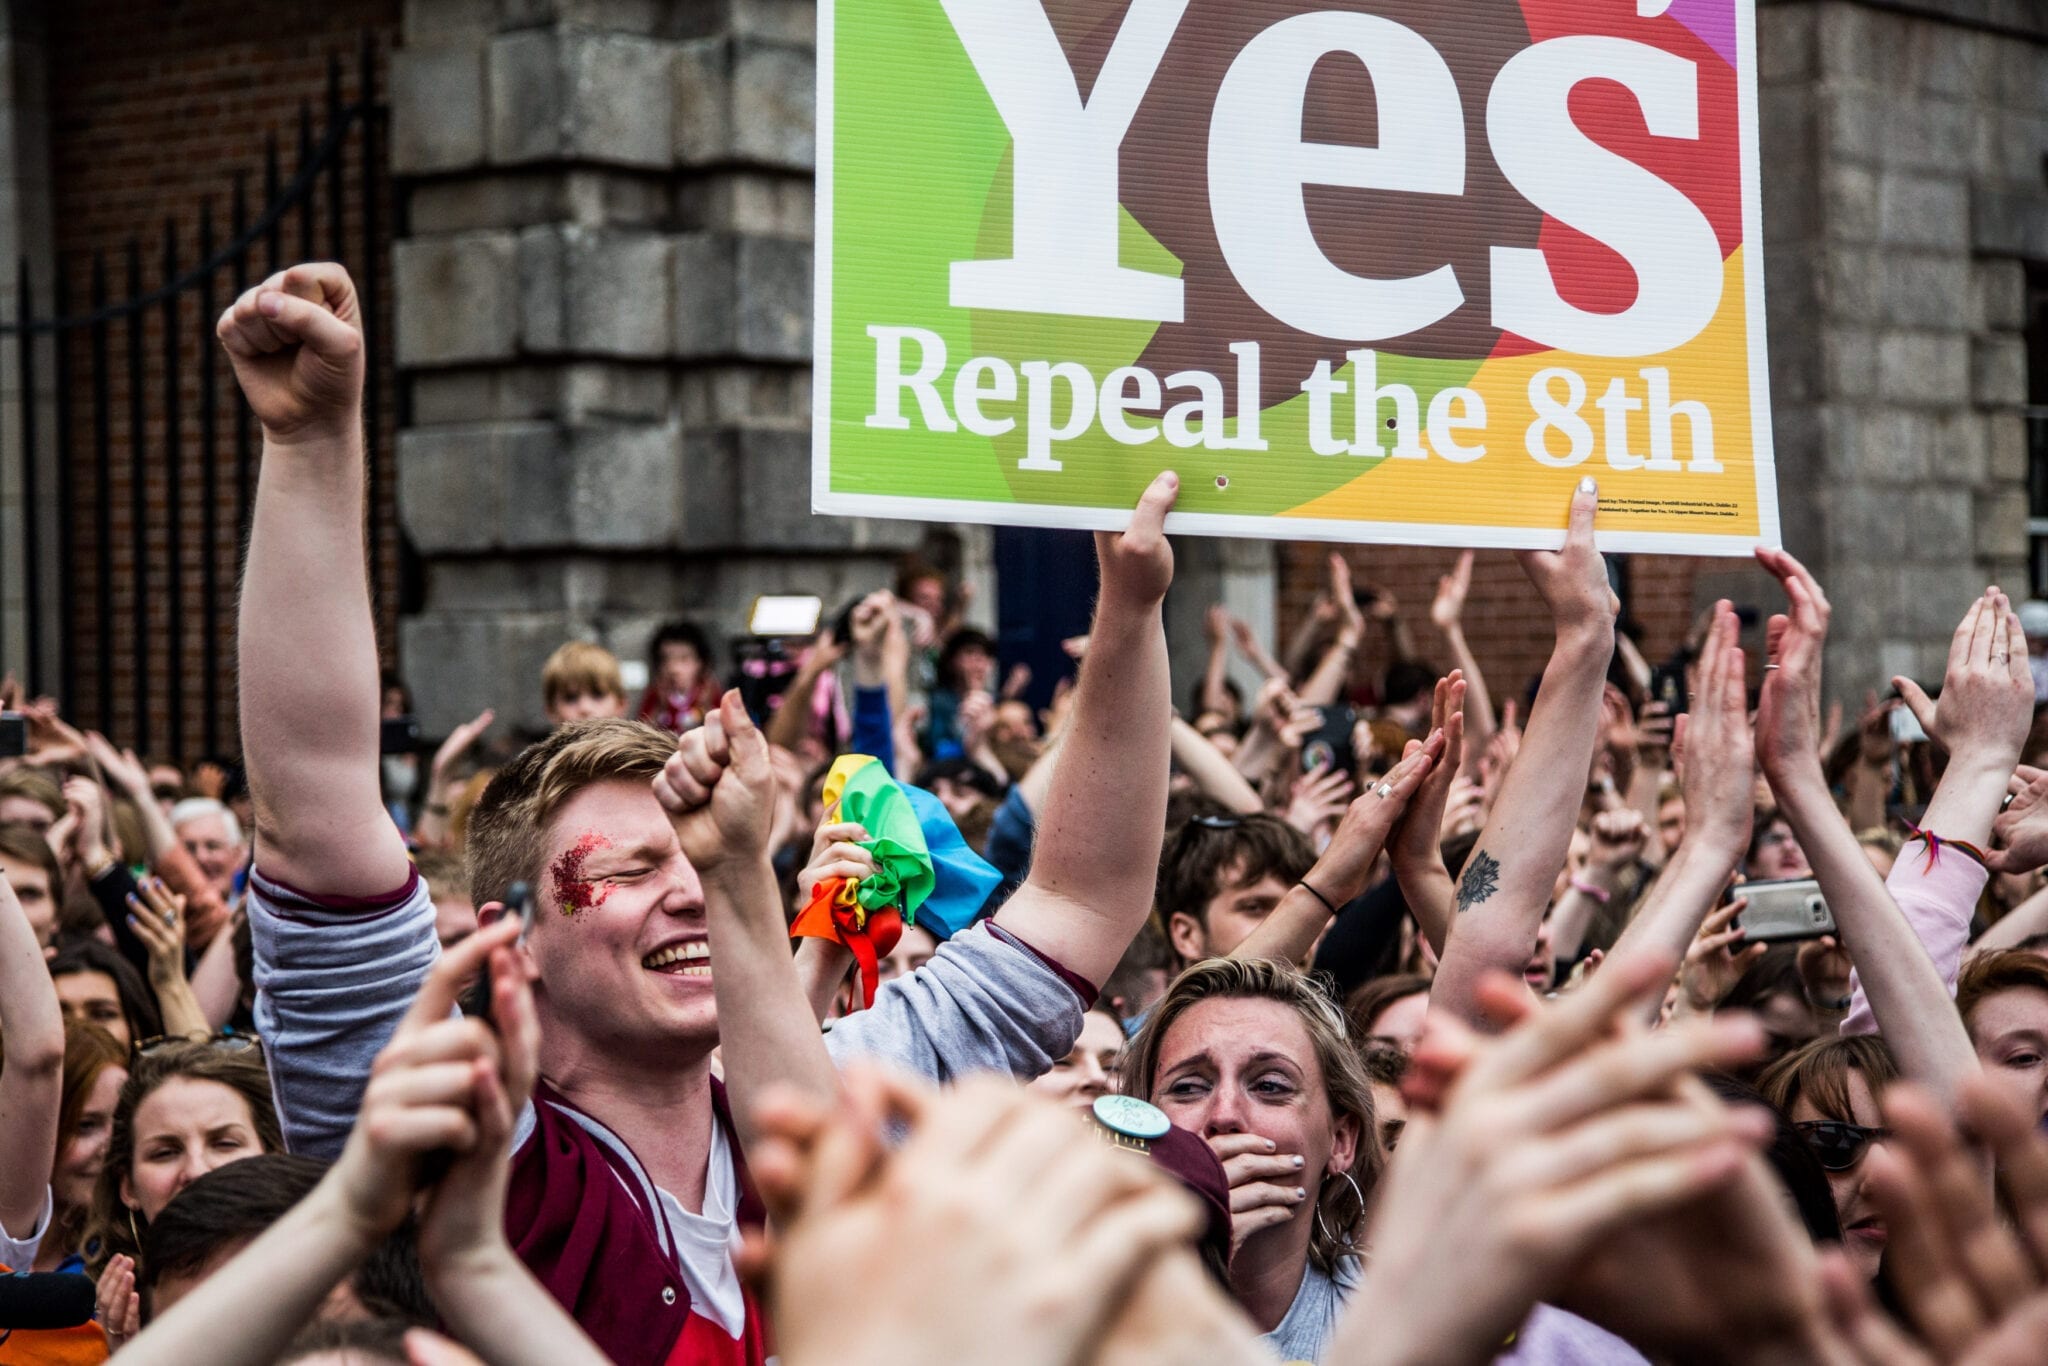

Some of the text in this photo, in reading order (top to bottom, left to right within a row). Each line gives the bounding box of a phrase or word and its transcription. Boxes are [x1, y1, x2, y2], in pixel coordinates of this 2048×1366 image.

[940, 0, 1723, 358] Yes
[865, 324, 1724, 474] Repeal the 8th
